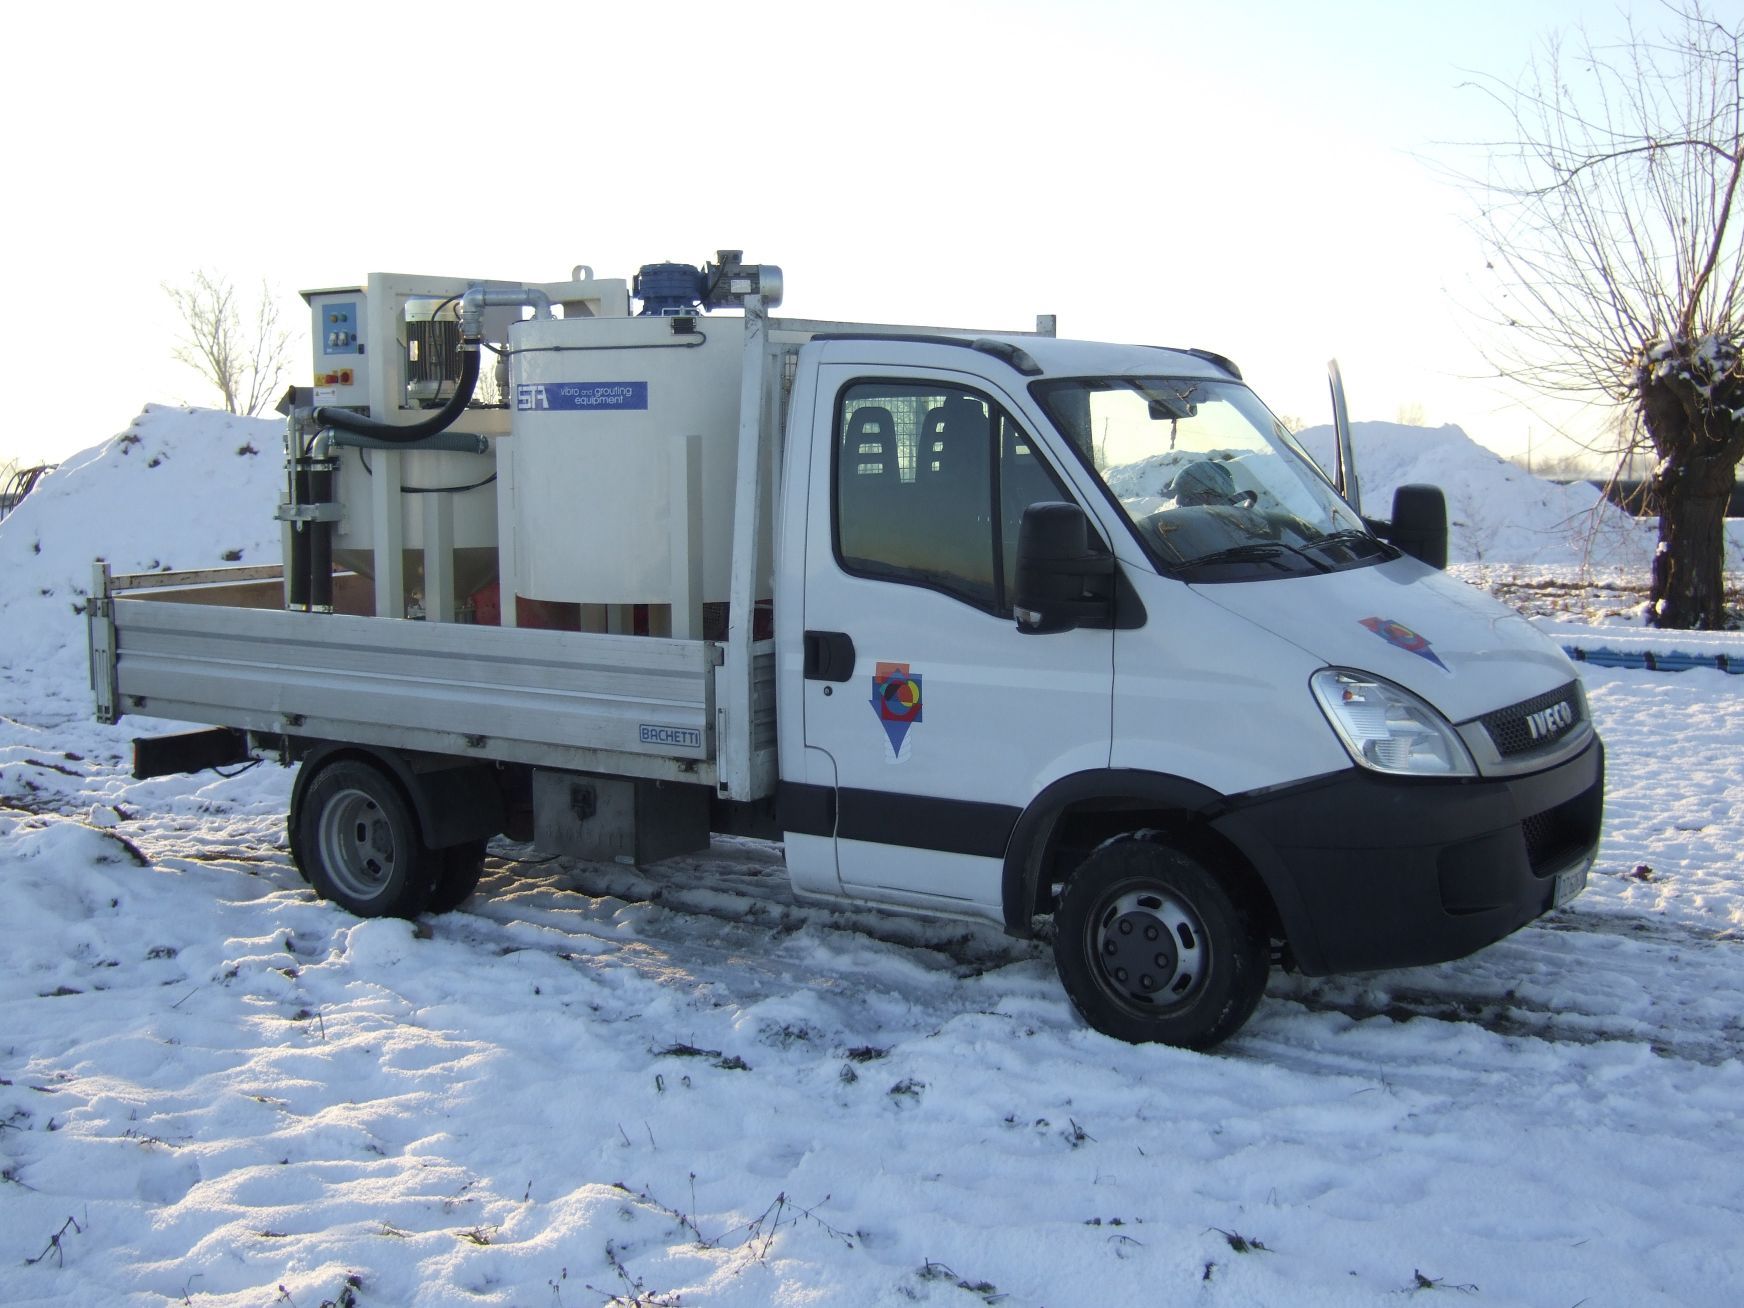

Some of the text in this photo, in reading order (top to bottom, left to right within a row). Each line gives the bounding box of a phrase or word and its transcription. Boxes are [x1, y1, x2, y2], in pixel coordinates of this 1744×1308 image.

[560, 387, 580, 396] vibro
[594, 386, 633, 397] grouting
[574, 395, 624, 406] equipment
[1526, 701, 1572, 739] IVECO
[641, 727, 699, 745] BACHETTI
